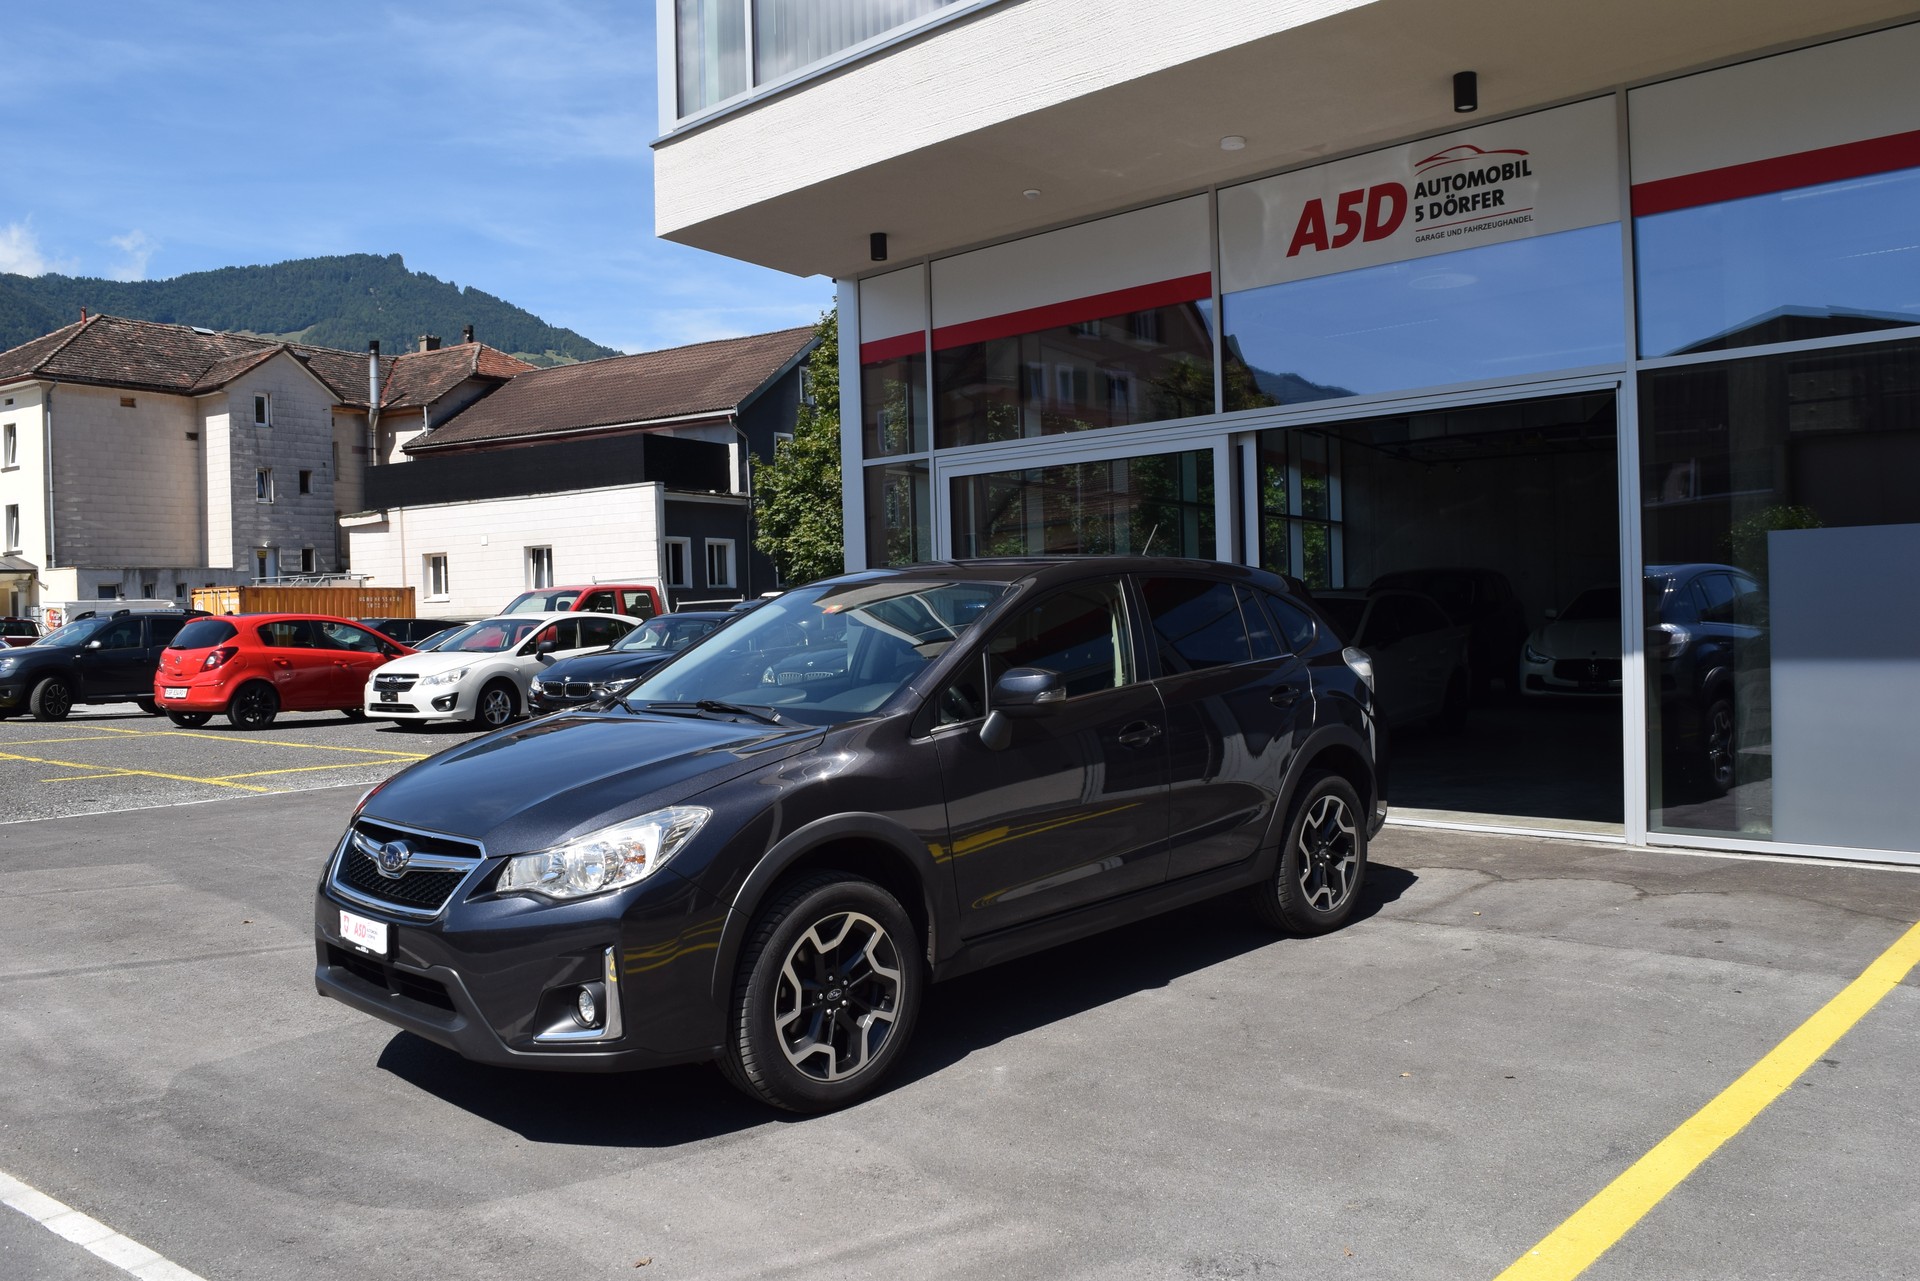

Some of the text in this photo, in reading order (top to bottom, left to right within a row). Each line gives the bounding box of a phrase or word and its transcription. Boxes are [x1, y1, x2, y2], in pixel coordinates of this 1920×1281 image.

[1414, 159, 1532, 199] AUTOMOBIL
[1286, 182, 1408, 257] A5D
[1415, 189, 1505, 222] 5 DÖRFER
[1415, 215, 1533, 243] GARAGE UND FAHRZEUGHANDEL
